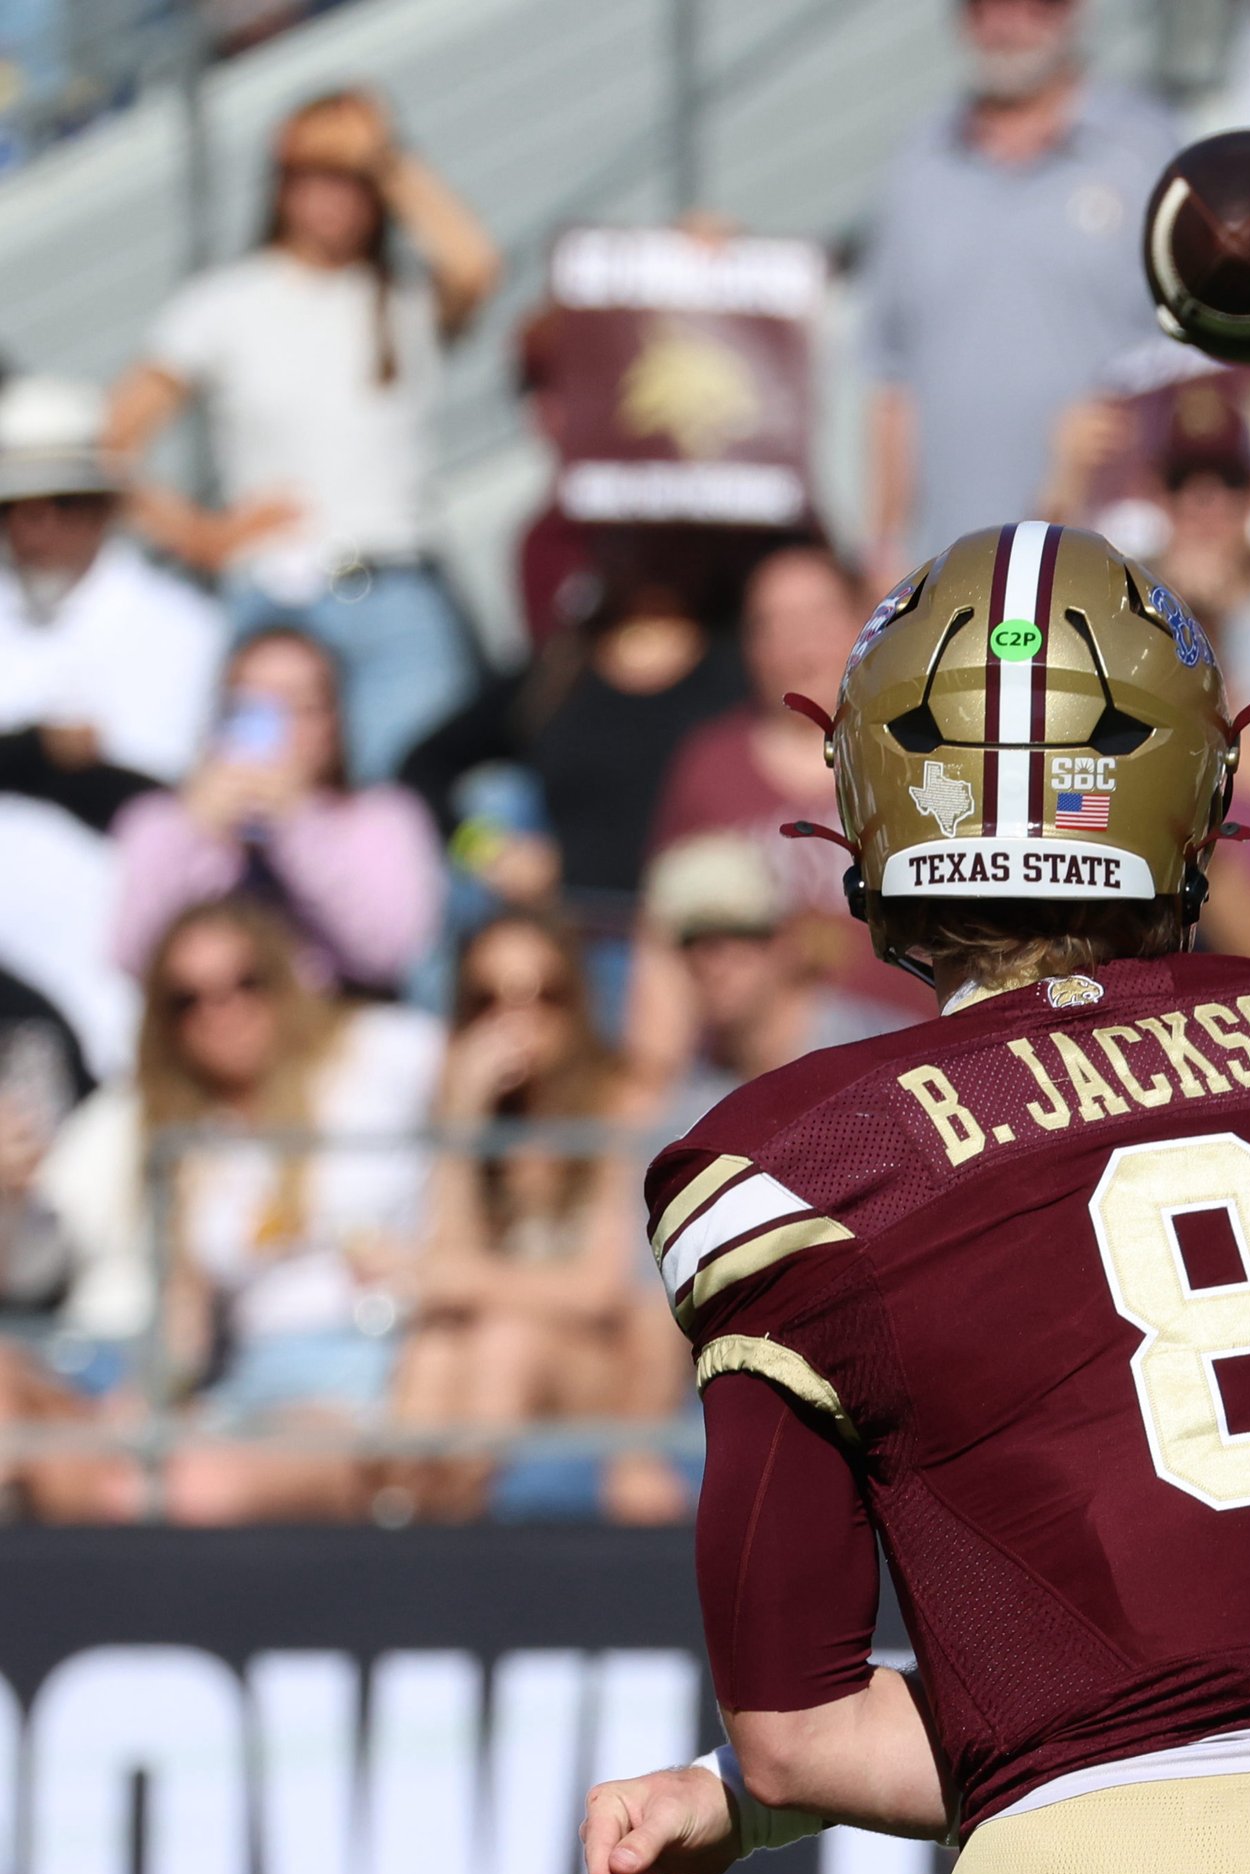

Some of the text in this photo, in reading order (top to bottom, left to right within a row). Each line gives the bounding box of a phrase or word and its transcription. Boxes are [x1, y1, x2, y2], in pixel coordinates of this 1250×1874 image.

[995, 631, 1036, 647] C2P
[1051, 757, 1116, 790] SBC
[909, 852, 1121, 890] TEXAS STATE
[897, 1065, 1016, 1167] B.
